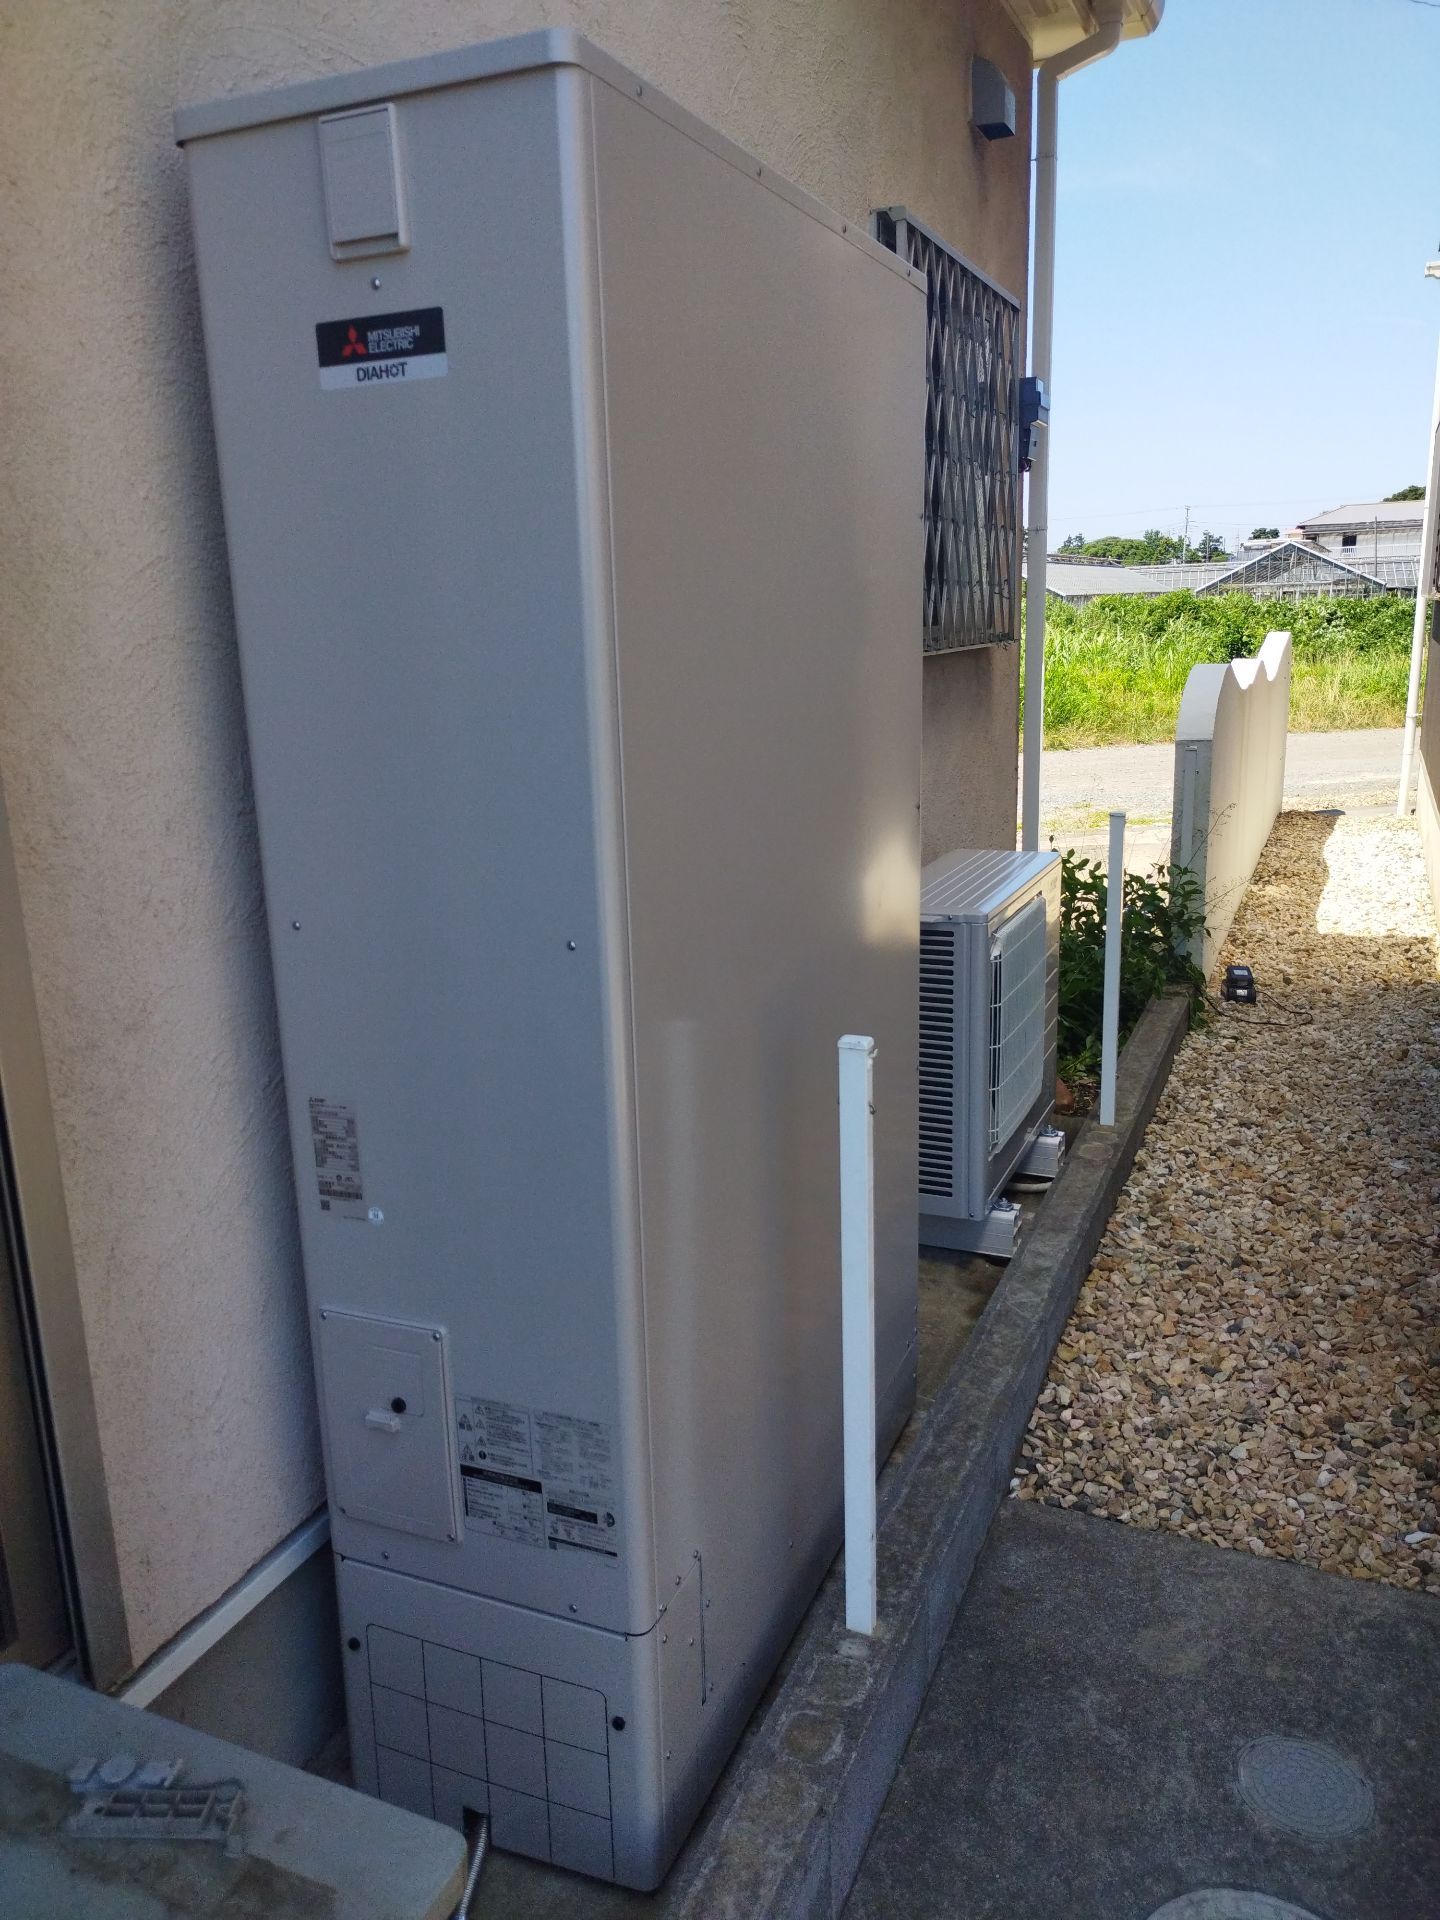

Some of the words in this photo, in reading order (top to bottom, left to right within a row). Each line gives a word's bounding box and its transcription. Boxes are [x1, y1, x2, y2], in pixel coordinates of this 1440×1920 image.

[366, 325, 421, 342] MITSUBISHI
[368, 339, 415, 353] ELECTRIC
[356, 361, 408, 382] DIAHOT
